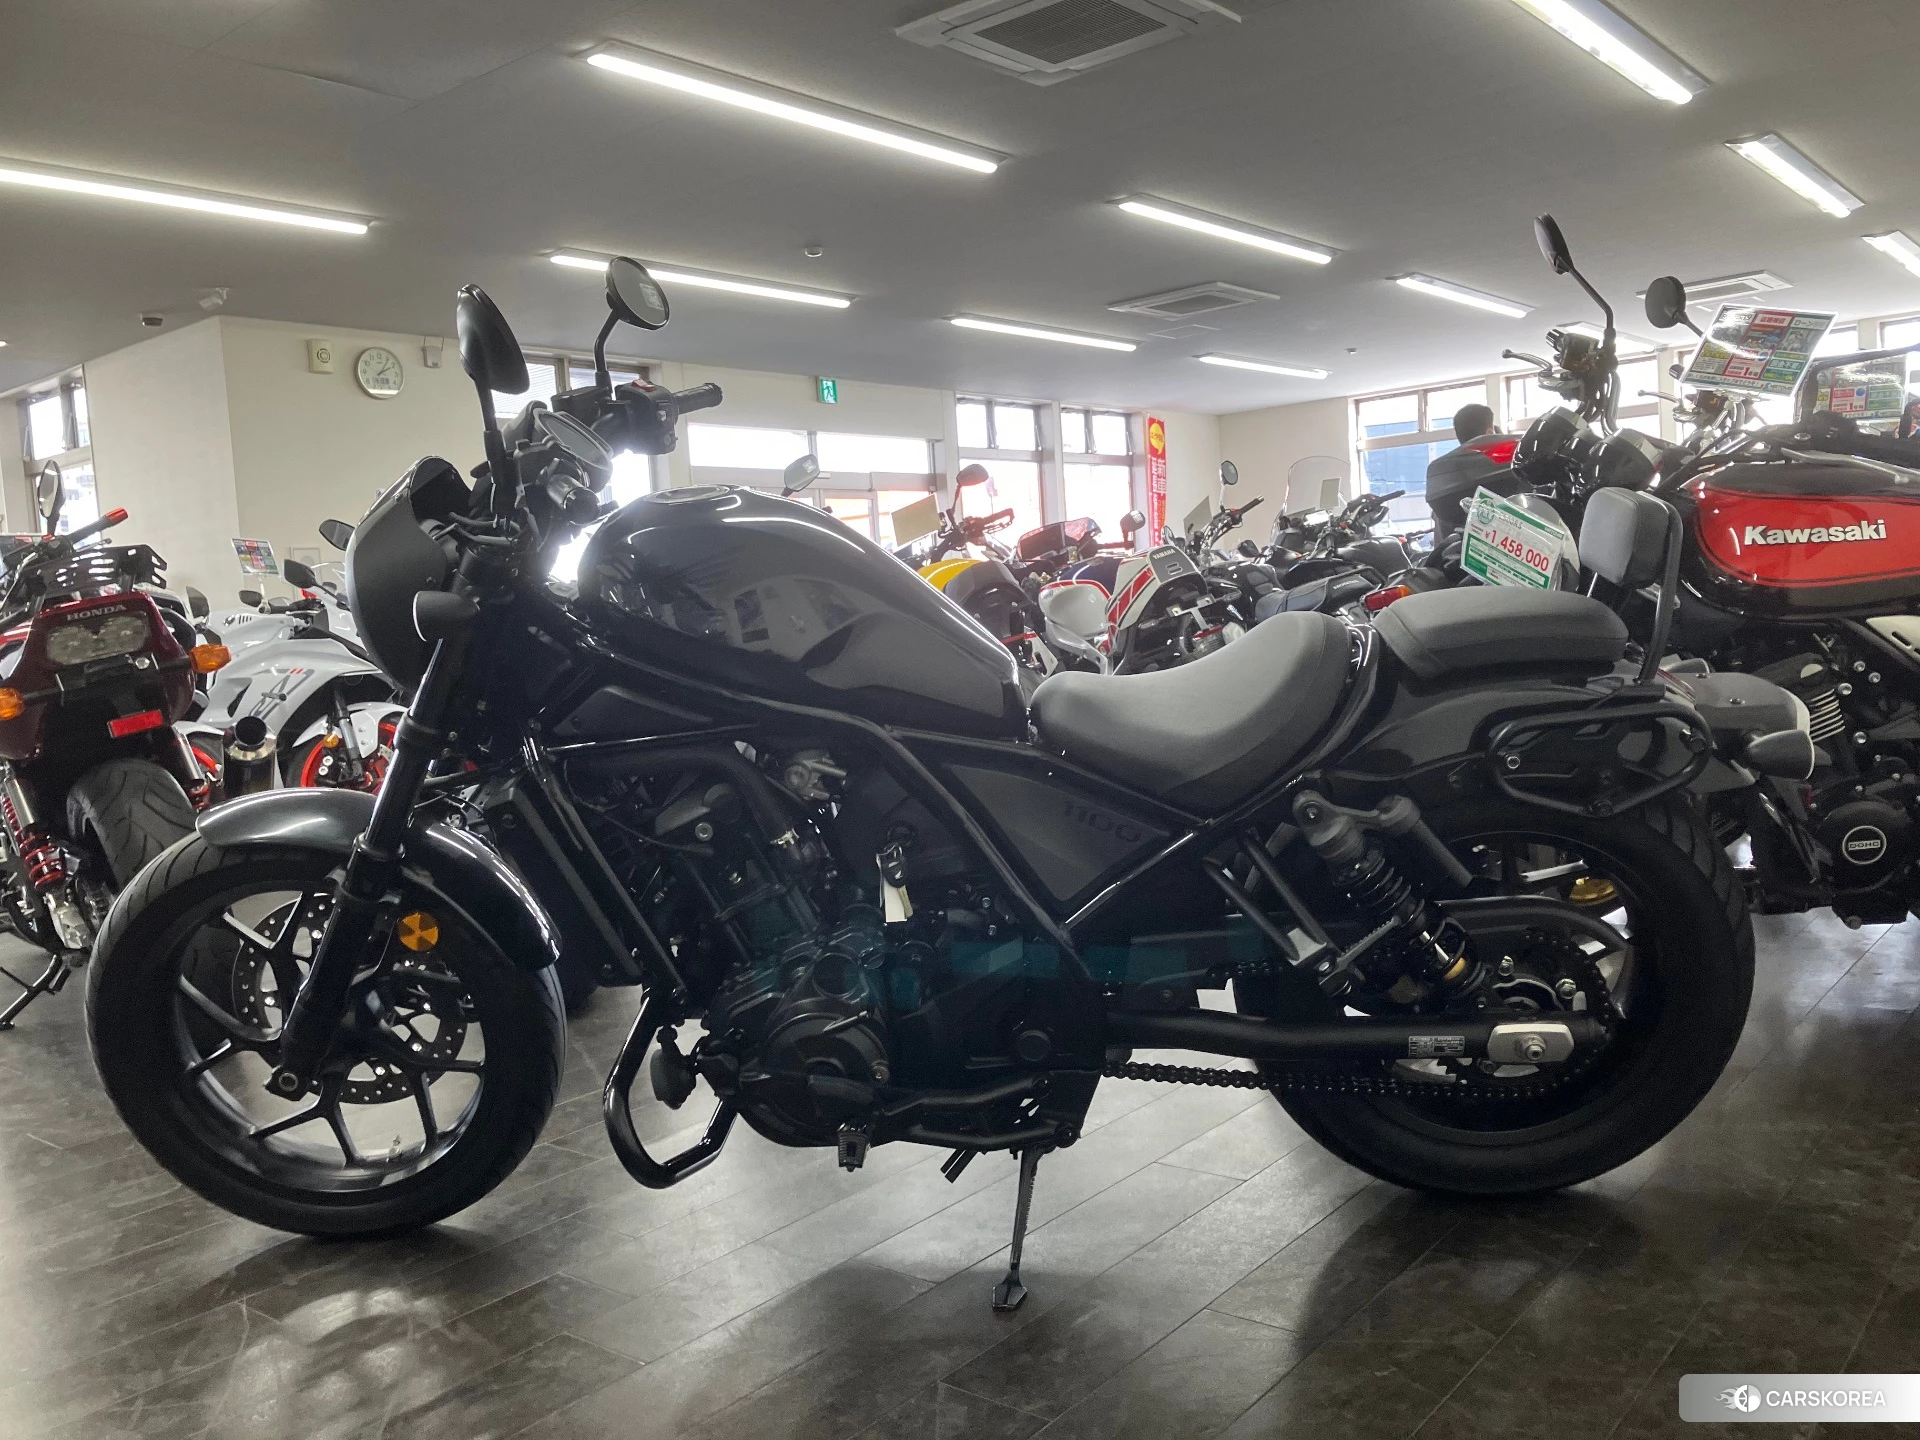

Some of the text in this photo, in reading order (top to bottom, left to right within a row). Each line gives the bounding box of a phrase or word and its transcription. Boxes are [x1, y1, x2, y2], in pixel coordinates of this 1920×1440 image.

[1744, 519, 1887, 546] Kawasaki
[1152, 548, 1176, 560] YAMAHA
[66, 604, 127, 621] HONDA
[1849, 841, 1880, 850] DOHC
